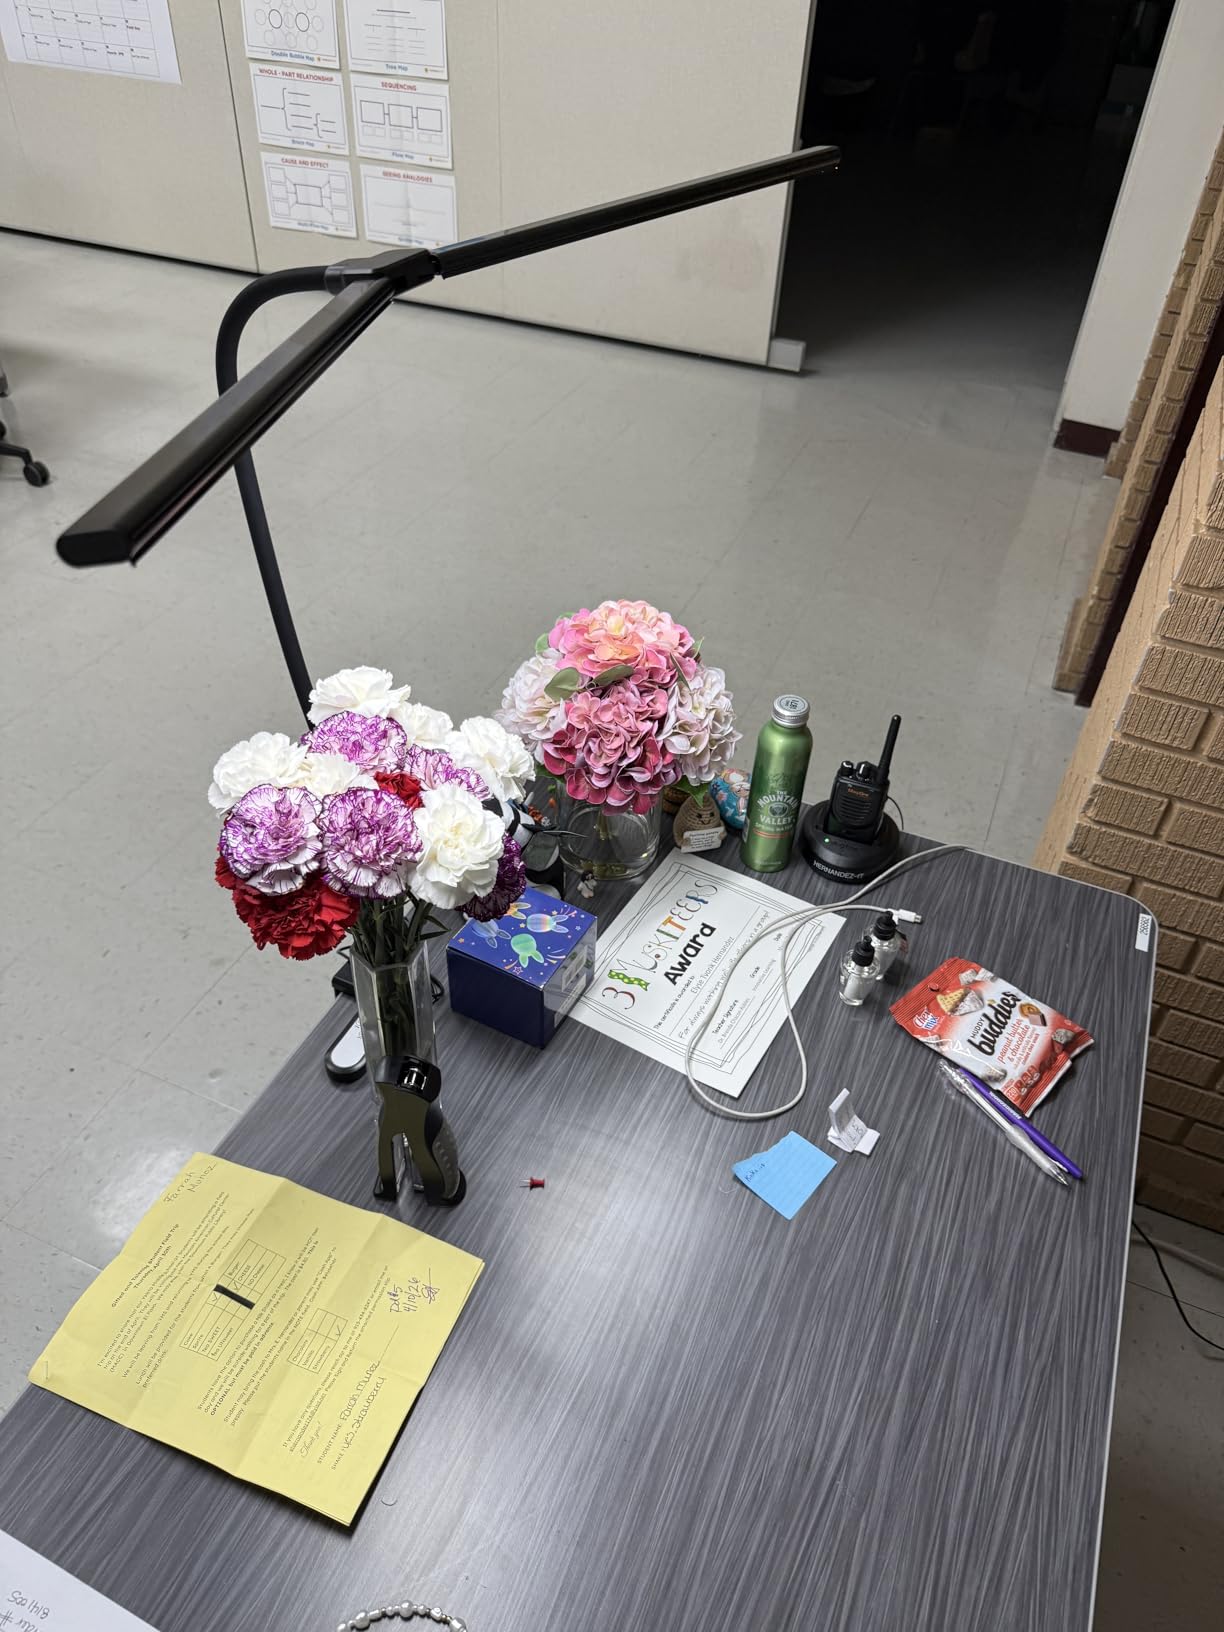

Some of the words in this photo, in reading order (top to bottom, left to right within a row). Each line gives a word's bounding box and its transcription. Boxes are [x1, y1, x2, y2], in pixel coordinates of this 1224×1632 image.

[296, 73, 334, 81] RELATIONSHIP
[381, 82, 416, 91] SEQUENCING
[759, 814, 794, 826] VALLEY
[663, 922, 716, 985] Award
[710, 934, 735, 964] Hernandez
[748, 965, 761, 978] Grade
[602, 986, 636, 1010] 3
[659, 1000, 676, 1021] certificate
[675, 978, 692, 998] awarded
[711, 1017, 726, 1035] Teacher
[722, 998, 740, 1019] Signature
[912, 1005, 932, 1028] Chex
[967, 992, 1021, 1056] buddies
[970, 1018, 986, 1039] MUDDY
[998, 1038, 1014, 1064] peanut
[1009, 1018, 1023, 1039] butter
[1010, 1024, 1031, 1058] chocolate
[110, 1291, 125, 1307] Gifted
[146, 1244, 163, 1264] Student
[160, 1232, 172, 1245] Field
[168, 1222, 180, 1233] Trip
[151, 1256, 165, 1269] April
[161, 1244, 171, 1256] 30th
[226, 1260, 242, 1276] Burger
[236, 1264, 251, 1281] CHEESE
[251, 1263, 264, 1278] Cheese
[108, 1352, 125, 1373] (MACC)
[125, 1319, 144, 1345] Downtown
[134, 1367, 147, 1384] Lunch
[154, 1328, 172, 1352] provided
[178, 1292, 194, 1313] students
[137, 1333, 153, 1352] leaving
[191, 1332, 205, 1349] Sprite
[206, 1325, 220, 1343] SWEET
[102, 1338, 117, 1357] excited
[230, 1349, 245, 1368] outside
[242, 1332, 258, 1351] walking
[291, 1338, 308, 1361] Chocolate
[301, 1348, 314, 1366] Vanilla
[140, 1362, 160, 1388] preferred
[196, 1386, 213, 1410] Students
[224, 1349, 238, 1366] option
[238, 1323, 256, 1345] purchase
[242, 1389, 255, 1406] Please
[263, 1352, 278, 1373] students
[209, 1386, 230, 1416] OPTIONAL
[222, 1401, 238, 1422] Student
[242, 1377, 255, 1392] bring
[316, 1438, 334, 1464] STUDENT
